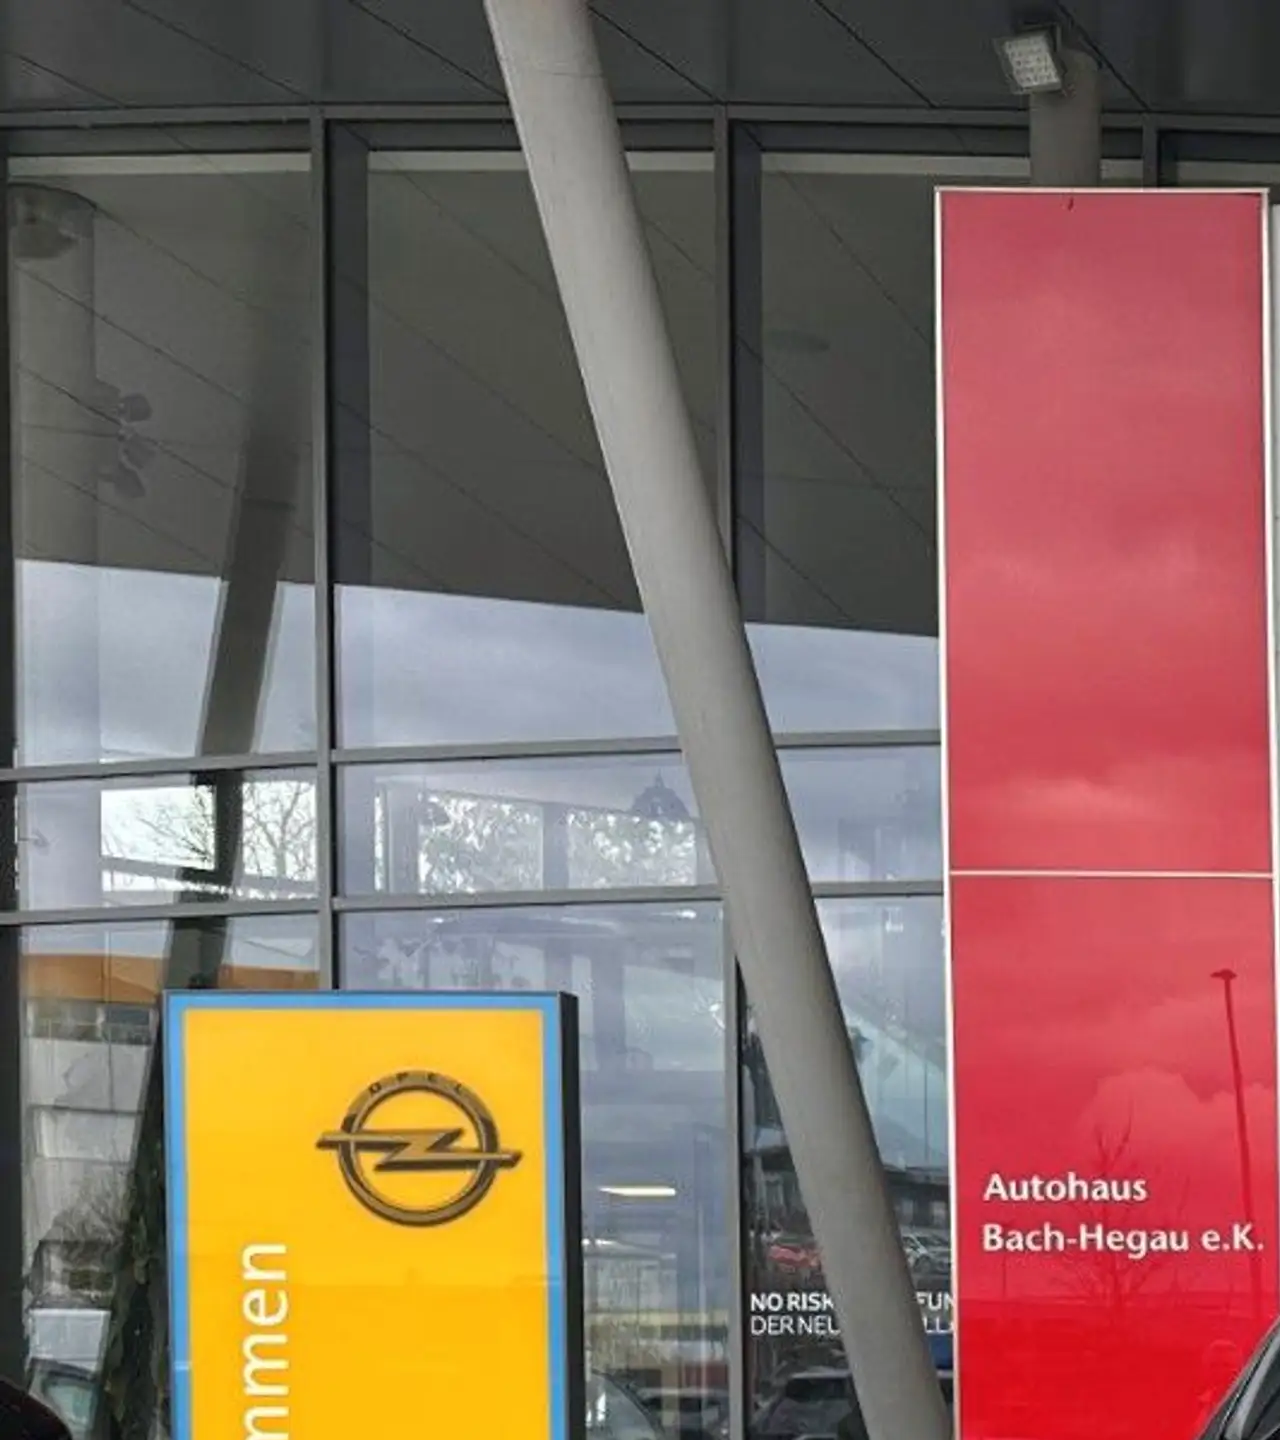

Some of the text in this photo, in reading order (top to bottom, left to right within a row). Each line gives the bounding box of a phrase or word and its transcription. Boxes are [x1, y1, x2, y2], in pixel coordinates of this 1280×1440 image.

[983, 1172, 1148, 1201] Autohaus
[983, 1222, 1264, 1259] Bach-Hegau e.K.
[751, 1292, 783, 1312] NO
[751, 1314, 795, 1335] DER
[799, 1314, 840, 1335] NEU
